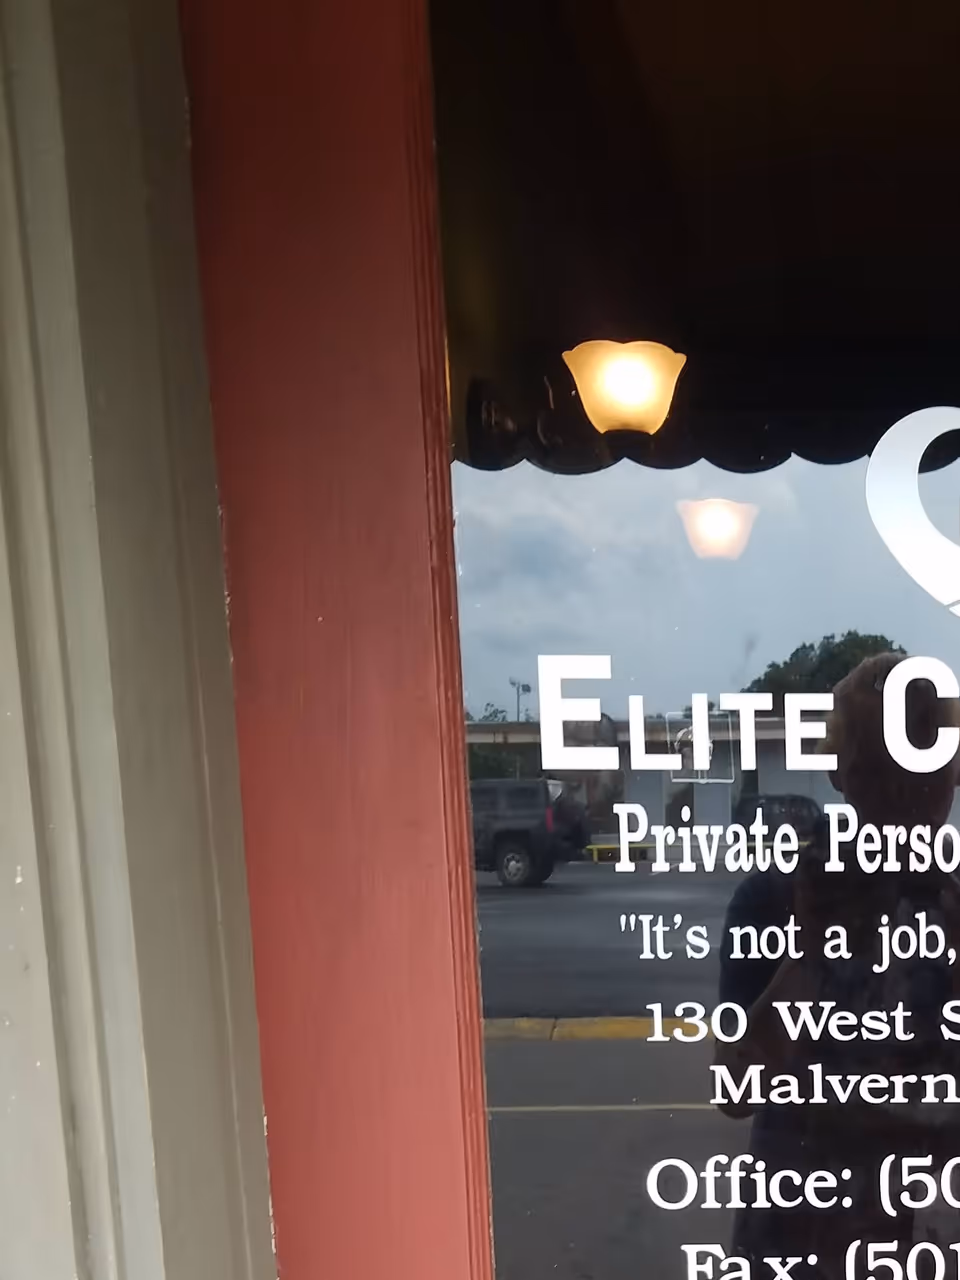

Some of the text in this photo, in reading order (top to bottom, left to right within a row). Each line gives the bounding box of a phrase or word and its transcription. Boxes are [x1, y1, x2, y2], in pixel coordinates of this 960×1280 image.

[538, 655, 838, 770] ELITE
[612, 803, 799, 874] Private
[729, 913, 804, 960] not
[824, 923, 852, 960] a
[872, 911, 957, 973] job,
[645, 1001, 748, 1043] 130
[772, 1000, 915, 1041] West
[646, 1154, 853, 1210] Office:
